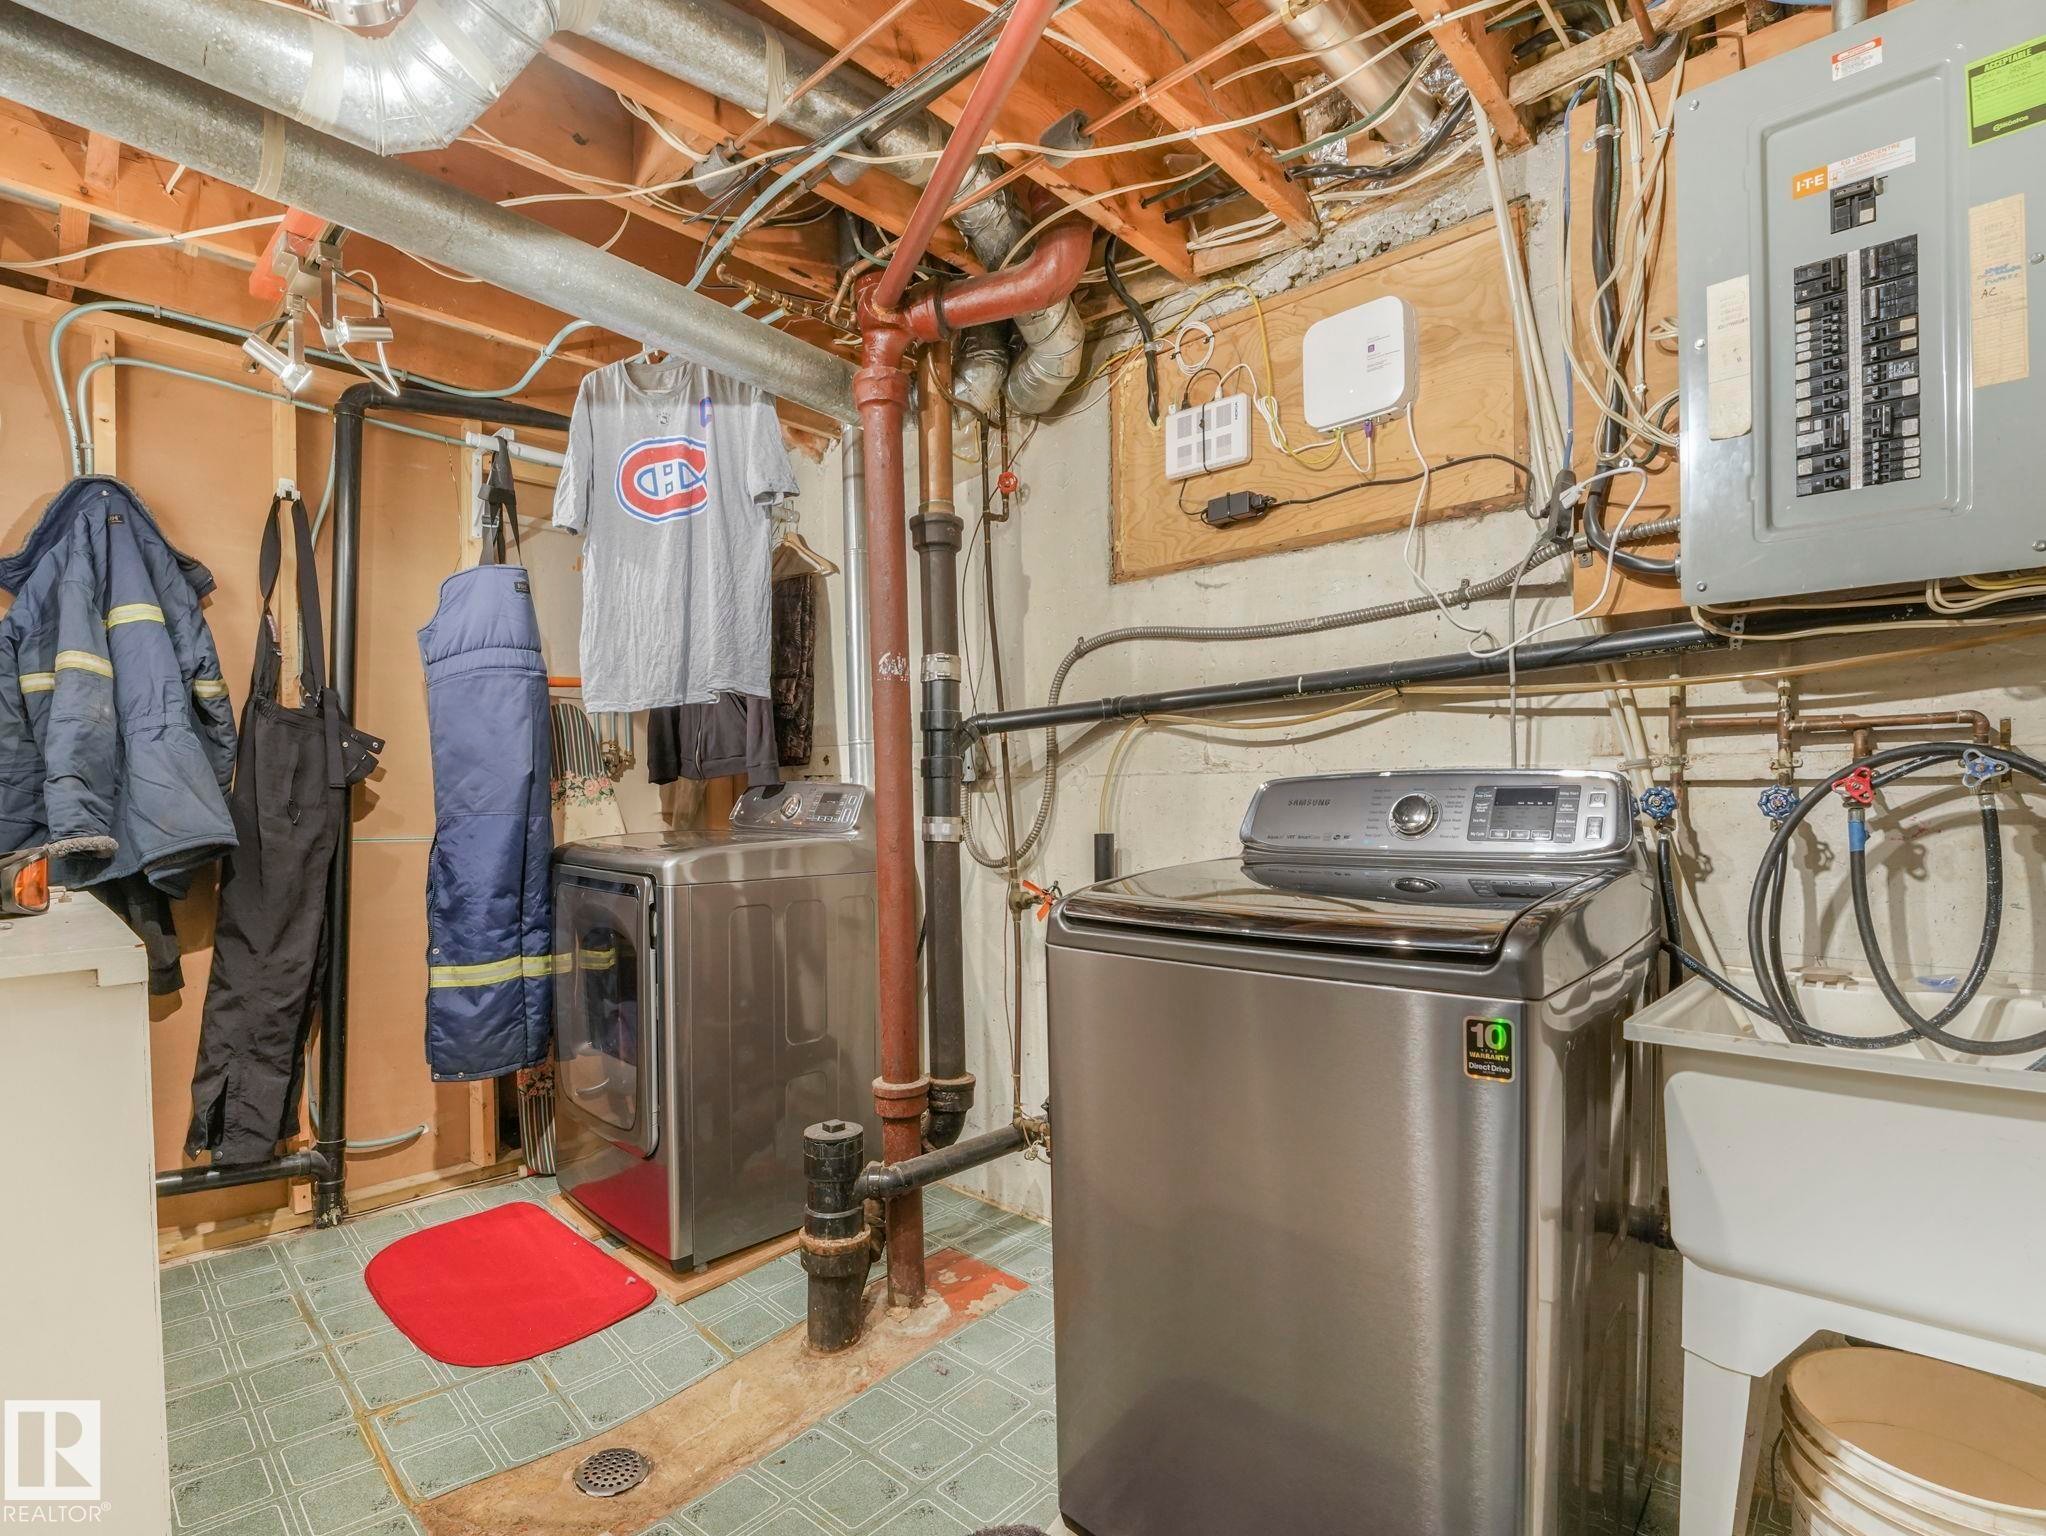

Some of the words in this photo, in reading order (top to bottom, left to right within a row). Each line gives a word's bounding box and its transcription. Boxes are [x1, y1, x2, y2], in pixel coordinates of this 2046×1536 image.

[1984, 47, 2032, 73] ACCEPTABLE
[1288, 799, 1331, 807] SAMSUNG
[1470, 1022, 1507, 1051] 10
[1469, 1051, 1509, 1062] WARRANTY
[1468, 1061, 1490, 1071] Direct
[1491, 1064, 1510, 1074] Drive
